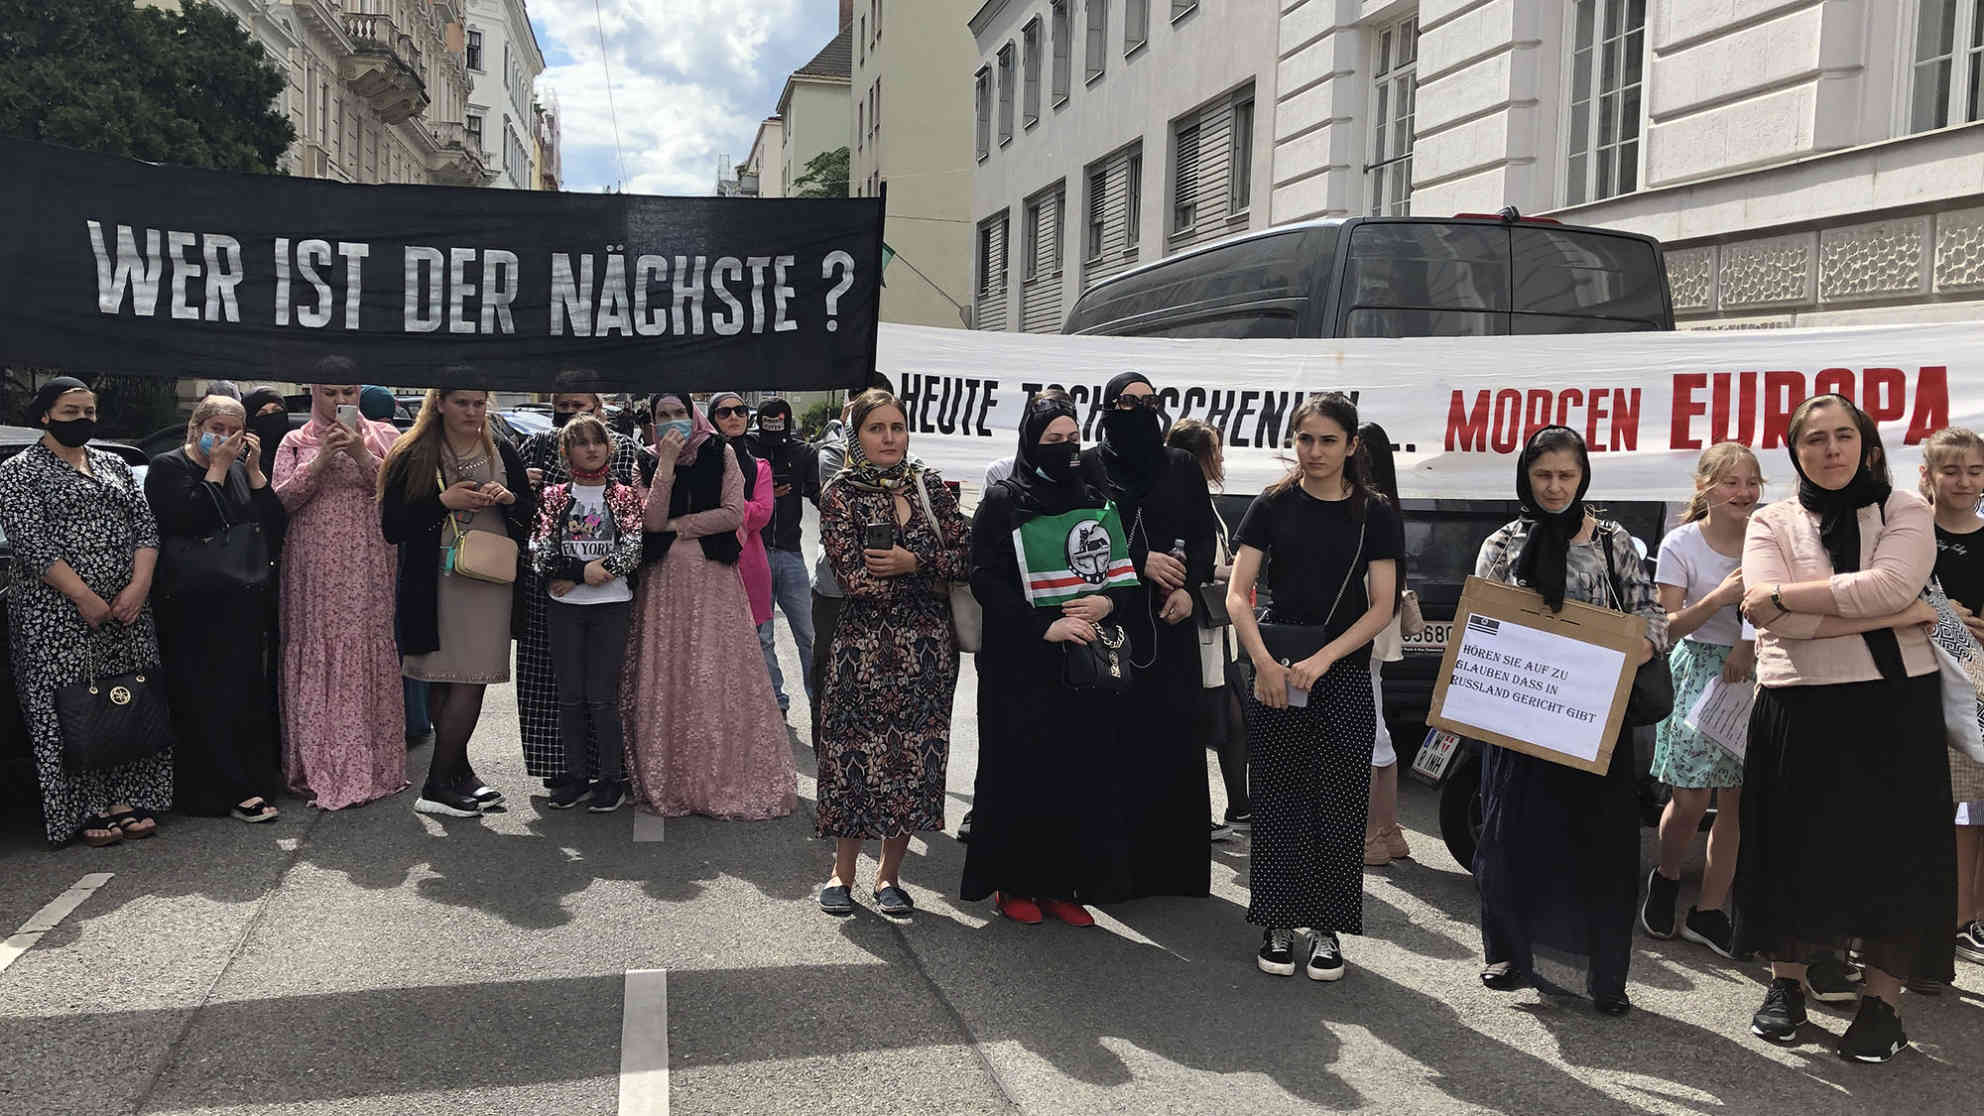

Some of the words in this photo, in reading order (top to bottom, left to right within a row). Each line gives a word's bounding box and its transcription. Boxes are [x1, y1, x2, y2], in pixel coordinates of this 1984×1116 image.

[87, 220, 243, 322] WER
[275, 238, 369, 329] IST
[404, 246, 519, 334] DER
[550, 244, 798, 337] NÄCHSTE
[822, 250, 855, 332] ?
[901, 373, 1000, 437] HEUTE
[1455, 659, 1510, 682] GLAUBEN
[1512, 674, 1544, 691] DASS
[1545, 682, 1559, 696] IN
[1463, 644, 1501, 663] HÖREN
[1502, 655, 1522, 668] SIE
[1524, 661, 1550, 675] AUF
[1551, 667, 1569, 681] ZU
[1450, 674, 1510, 699] RUSSLAND
[1512, 692, 1565, 715] GERICHT
[1566, 707, 1598, 724] GIBT
